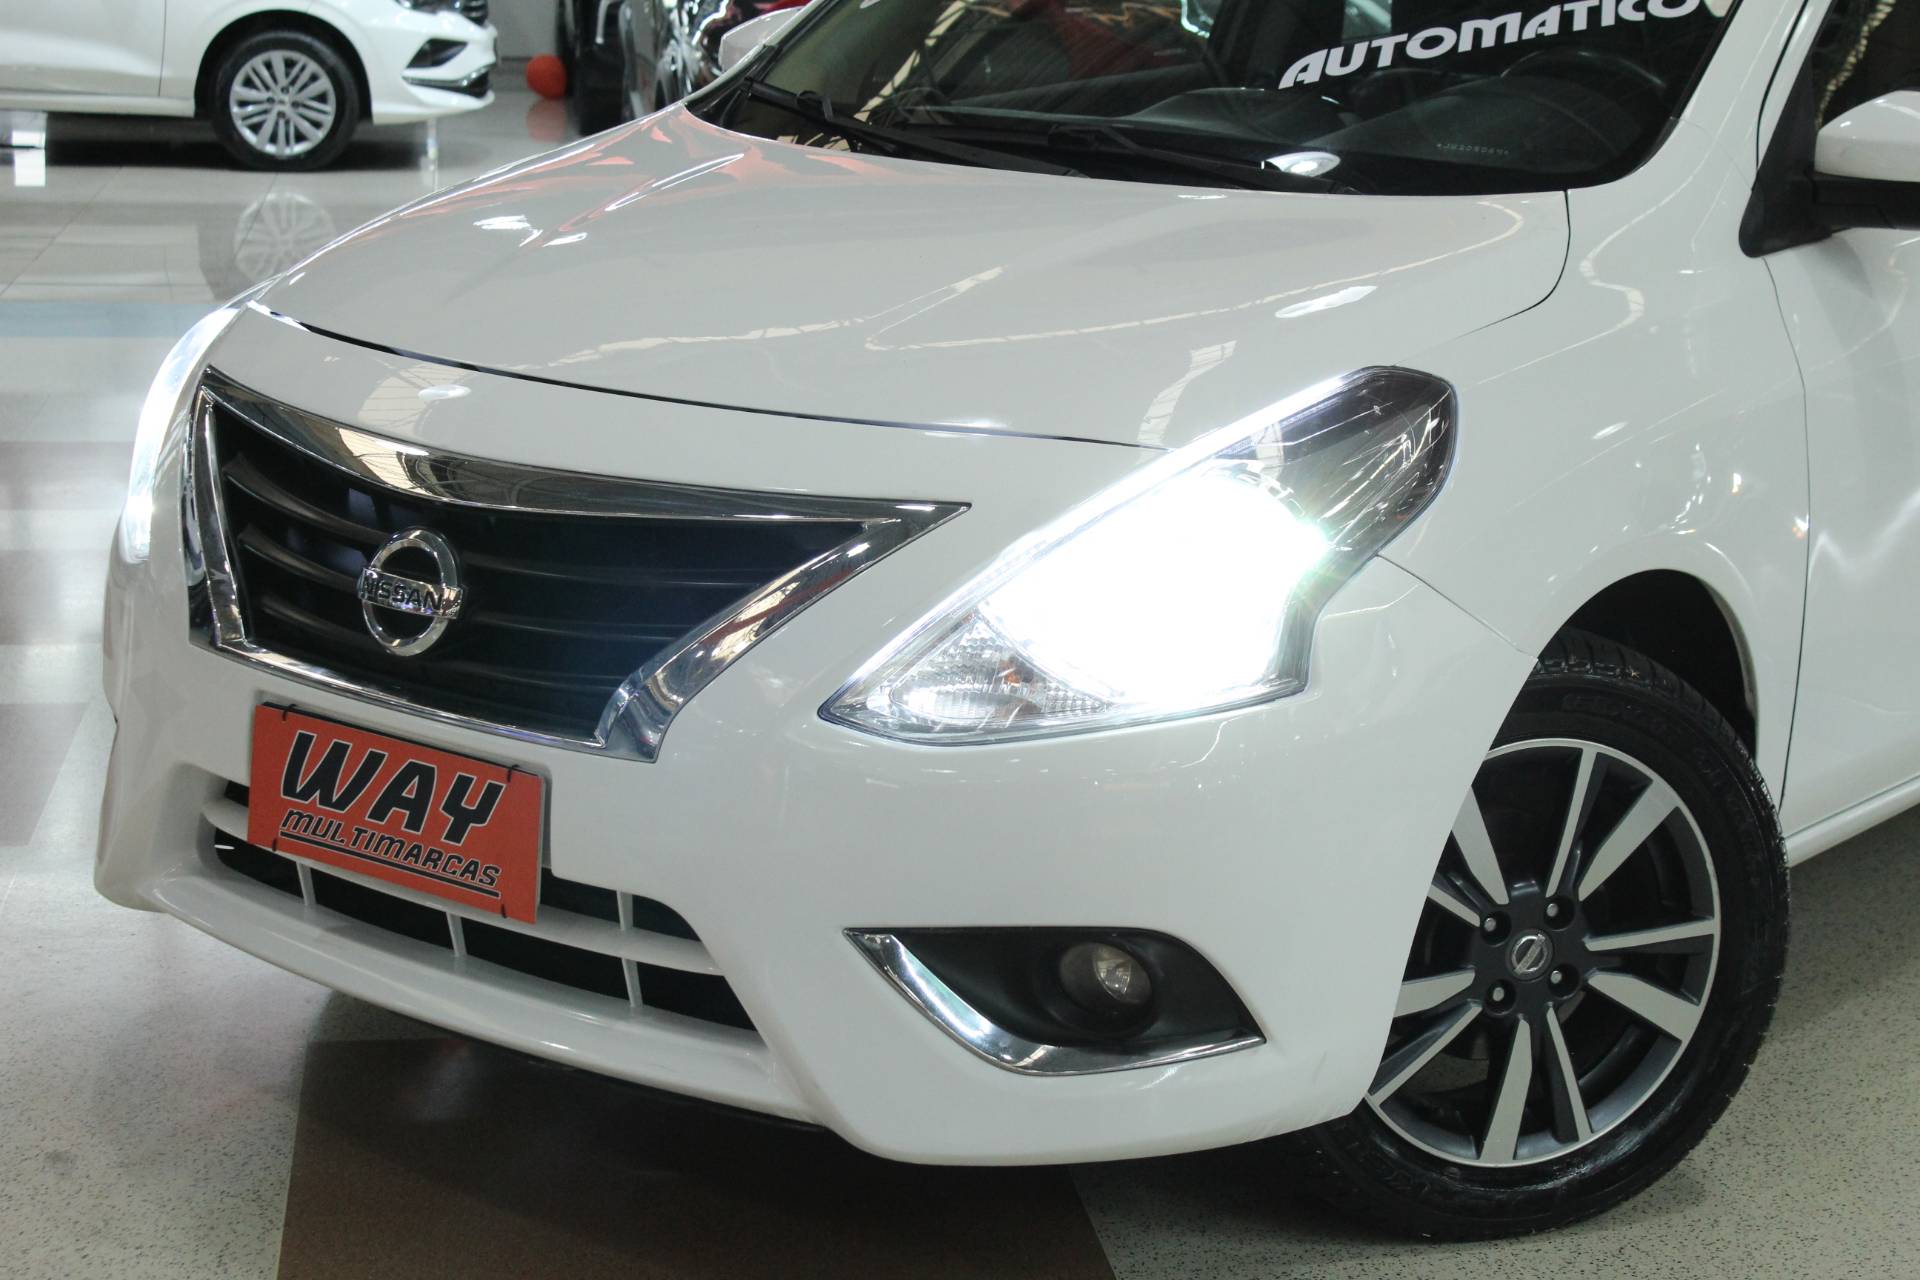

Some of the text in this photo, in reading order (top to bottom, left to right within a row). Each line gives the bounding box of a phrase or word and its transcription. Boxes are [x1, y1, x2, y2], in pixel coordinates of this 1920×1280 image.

[1278, 0, 1700, 90] AUTOMATICO
[362, 575, 444, 612] NISSAN
[280, 730, 505, 844] WAY
[280, 809, 501, 888] MULTIMARCAS
